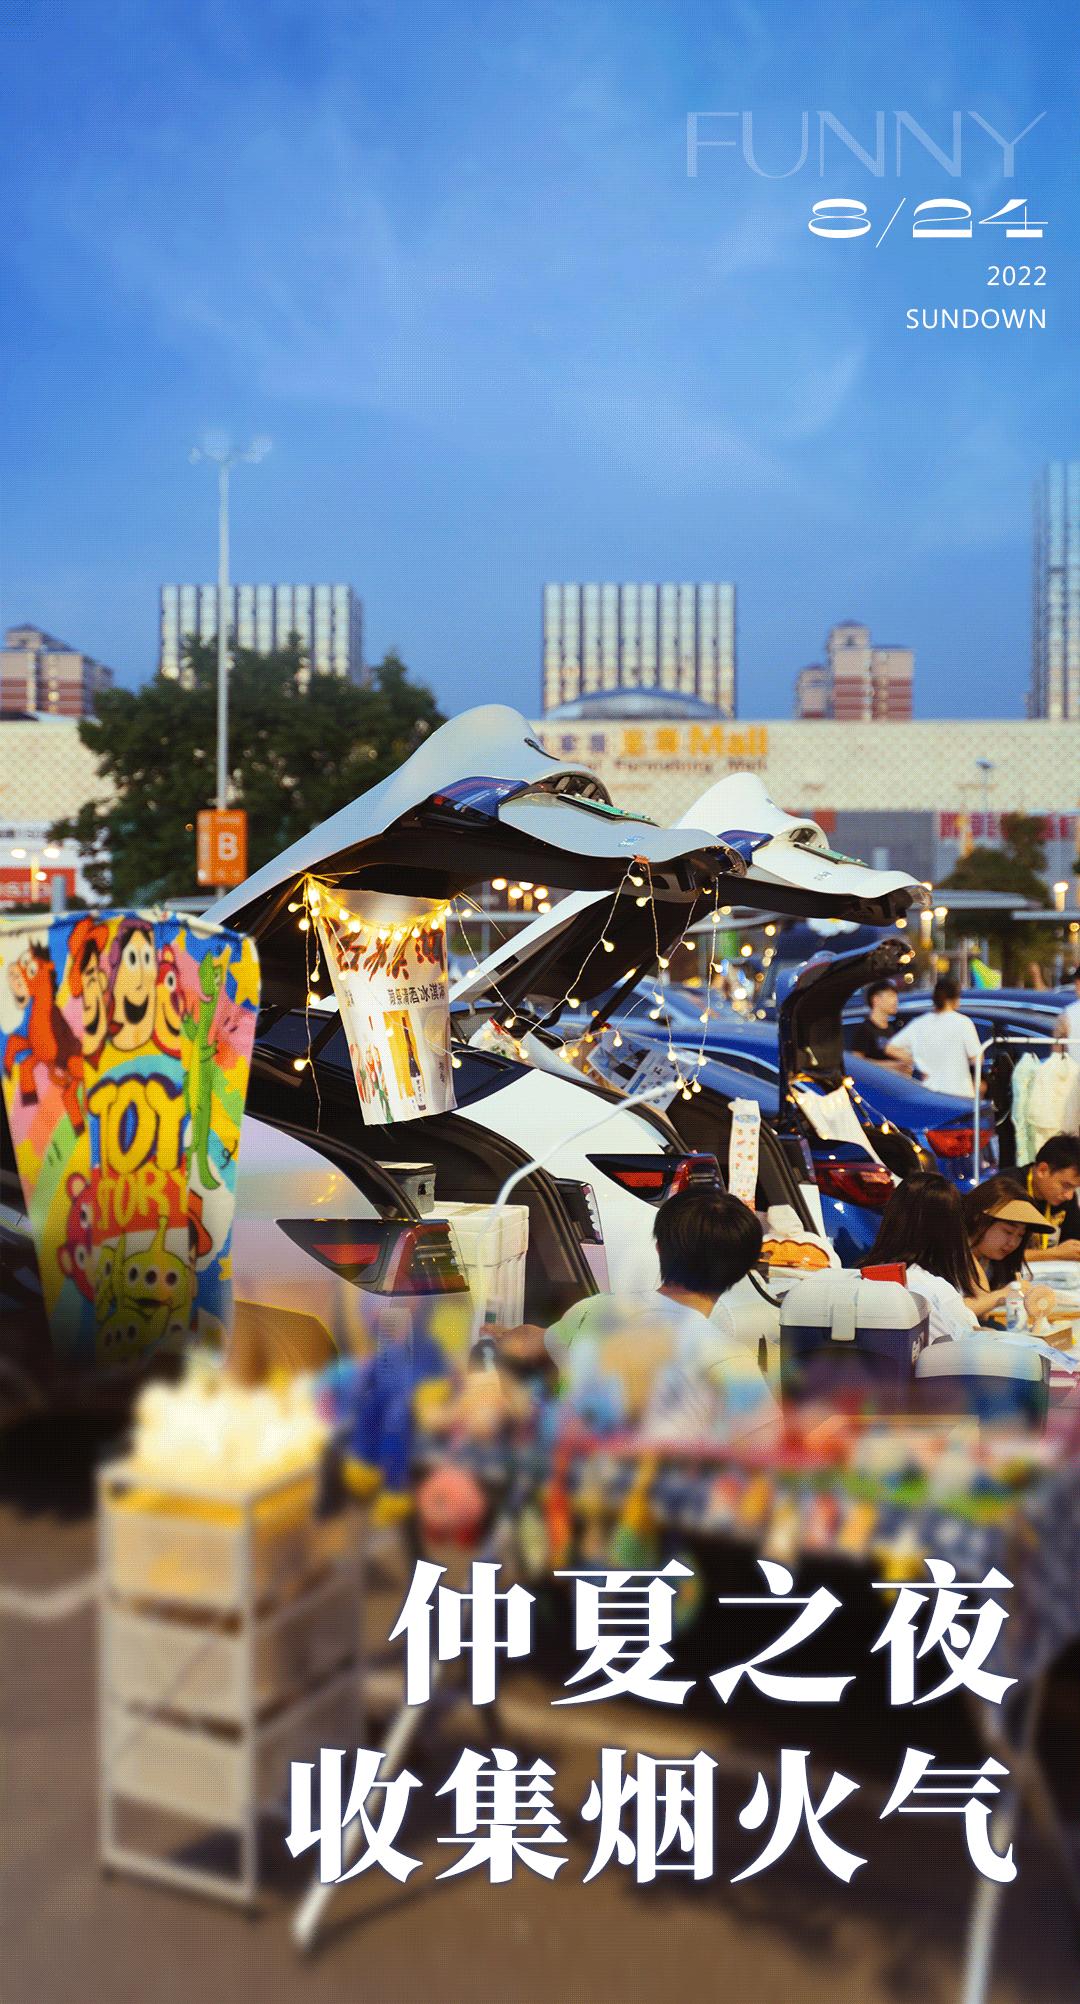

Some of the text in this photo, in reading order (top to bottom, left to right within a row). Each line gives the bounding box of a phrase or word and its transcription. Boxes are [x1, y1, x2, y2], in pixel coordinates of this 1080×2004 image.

[218, 832, 240, 861] B
[87, 1073, 187, 1173] TOY
[96, 1164, 187, 1231] TORY
